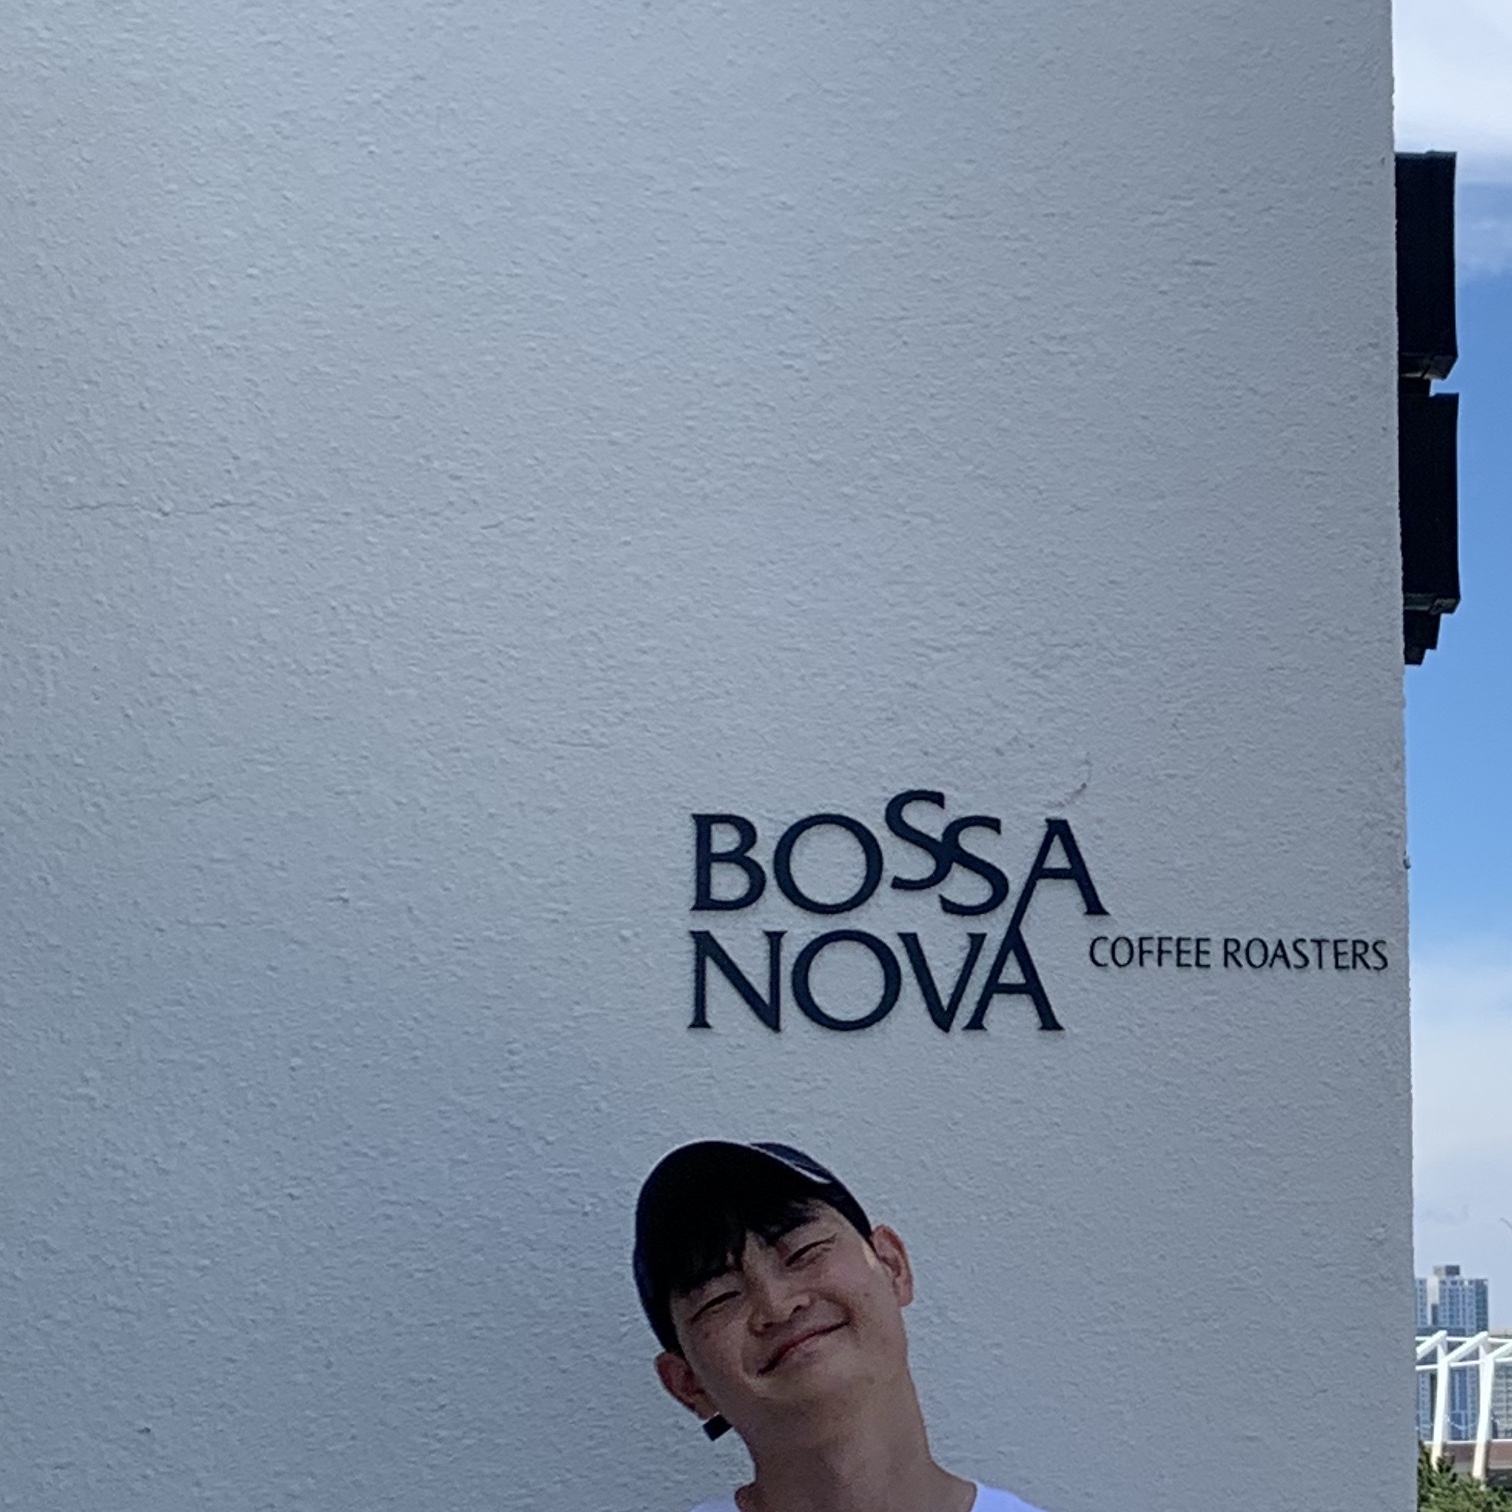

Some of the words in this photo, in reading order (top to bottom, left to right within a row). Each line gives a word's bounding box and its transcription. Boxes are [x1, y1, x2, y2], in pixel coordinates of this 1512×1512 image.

[689, 789, 1110, 917] BOSSA
[687, 924, 1065, 1033] NOVA
[1088, 935, 1212, 970] COFFEE
[1222, 936, 1390, 972] ROASTERS
